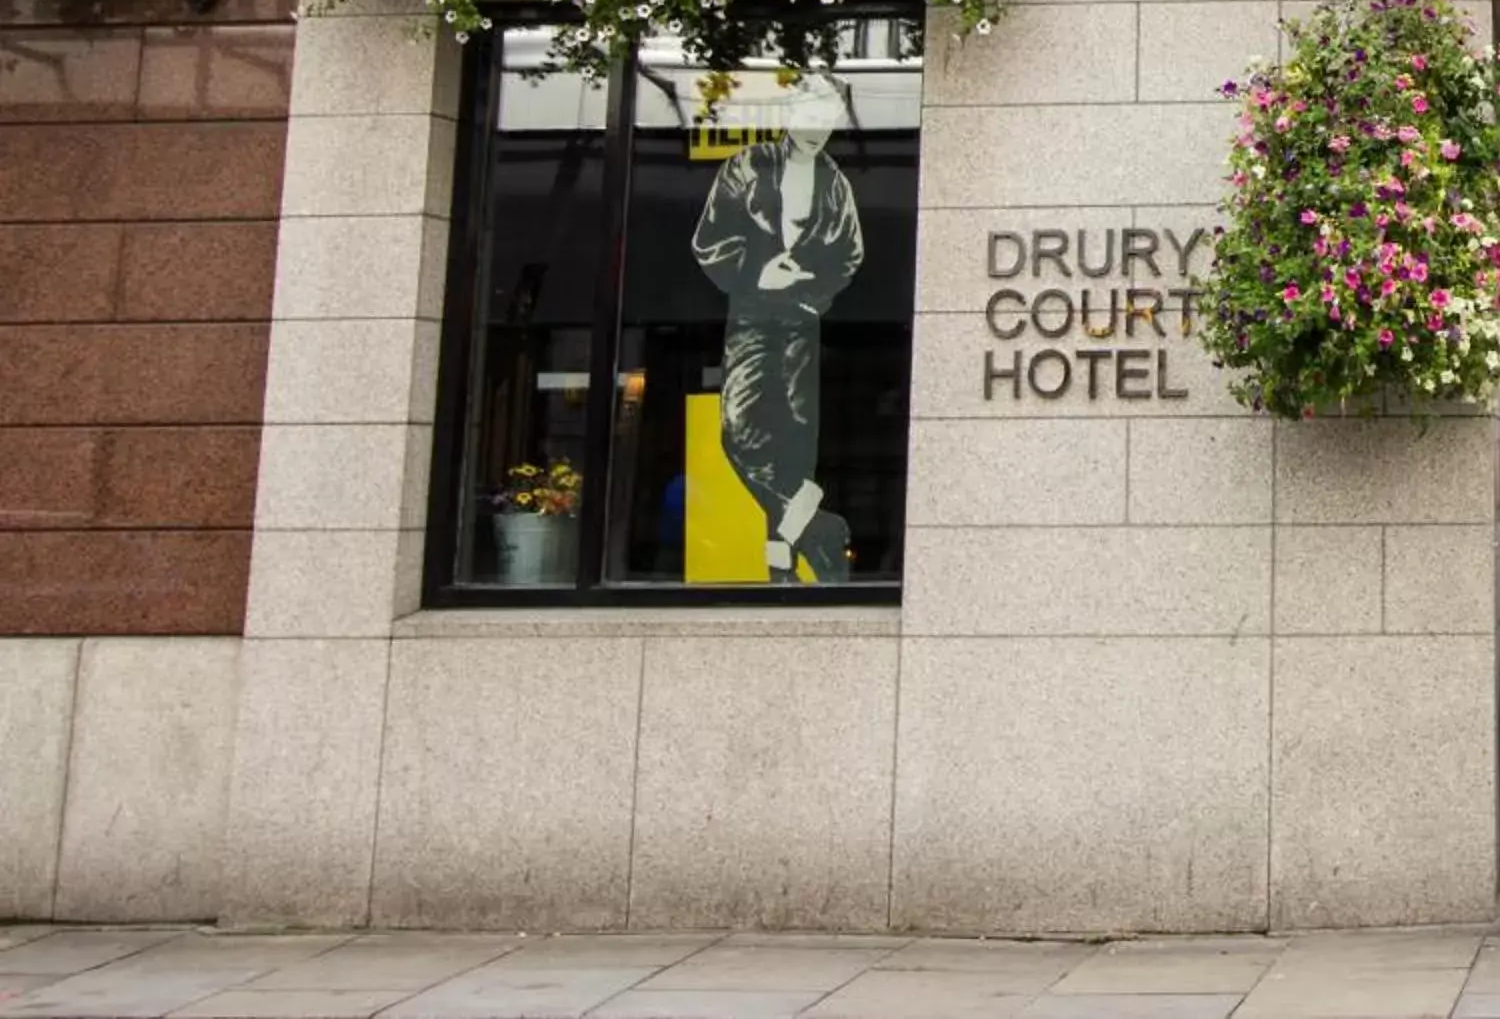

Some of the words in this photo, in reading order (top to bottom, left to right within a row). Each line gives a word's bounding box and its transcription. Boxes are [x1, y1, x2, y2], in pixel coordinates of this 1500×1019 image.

[987, 228, 1204, 278] DRURY
[986, 288, 1205, 339] COURT
[983, 348, 1189, 400] HOTEL
